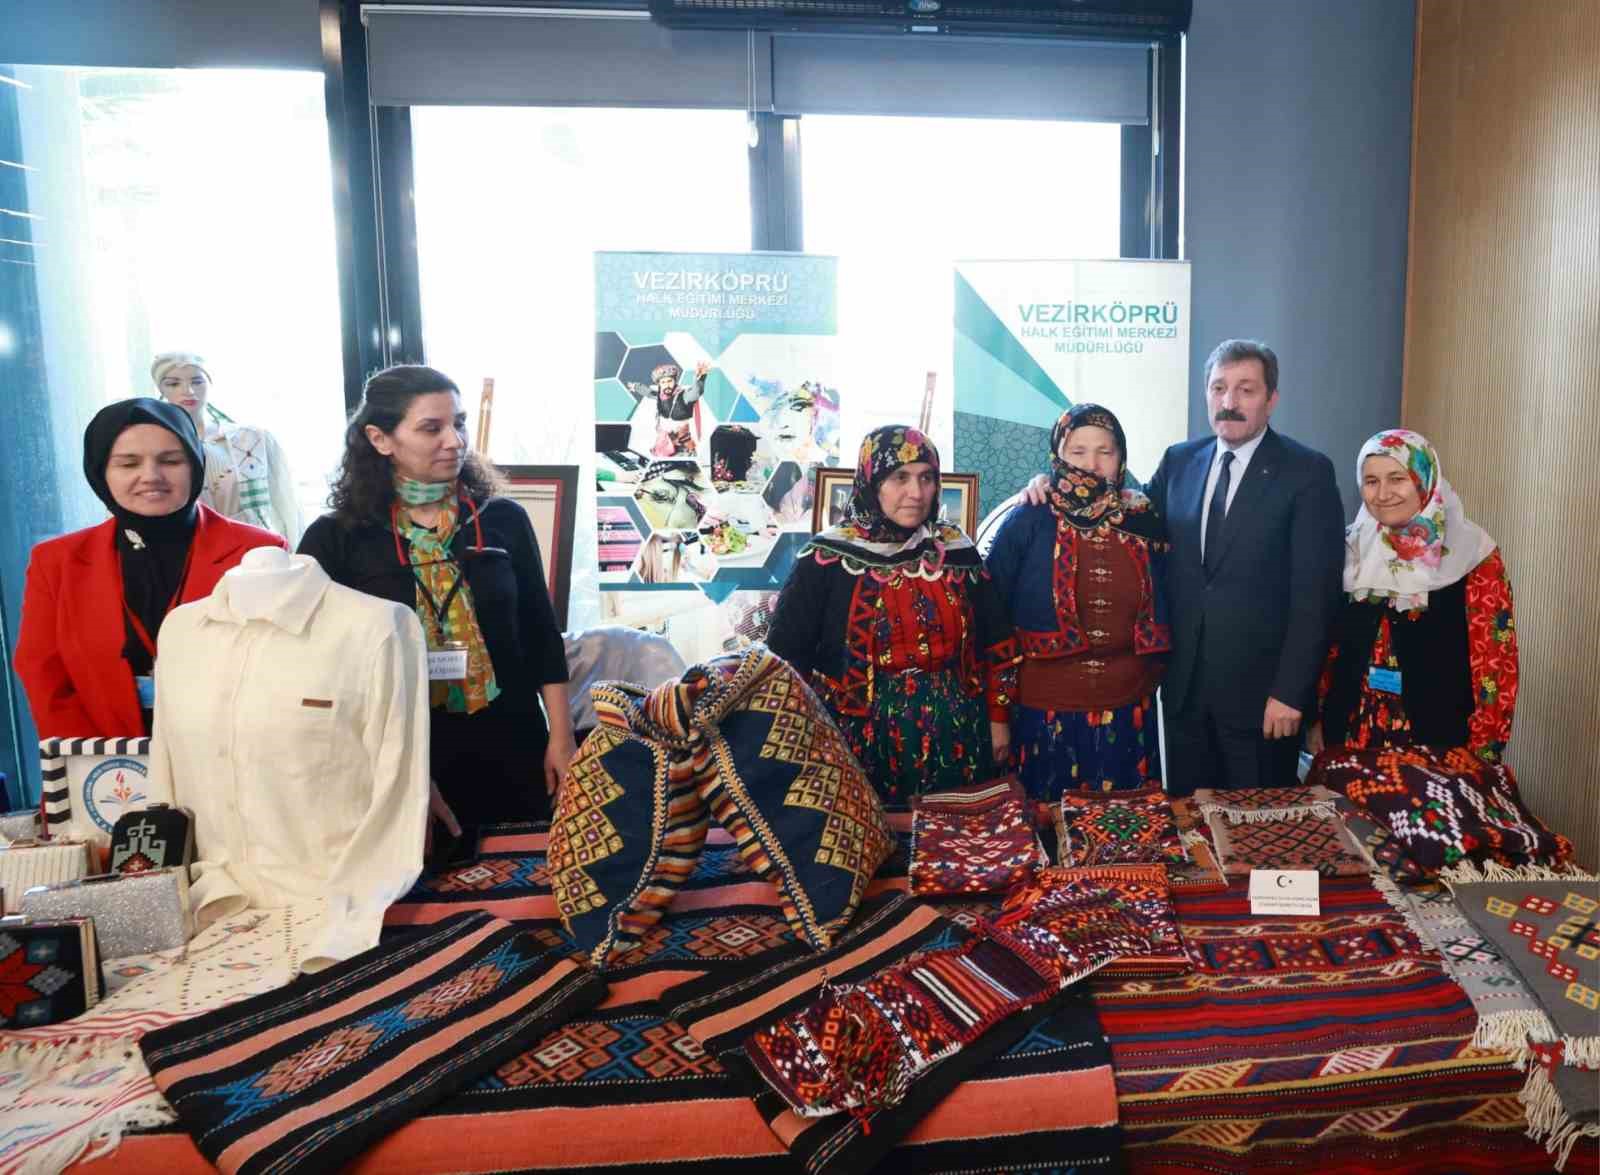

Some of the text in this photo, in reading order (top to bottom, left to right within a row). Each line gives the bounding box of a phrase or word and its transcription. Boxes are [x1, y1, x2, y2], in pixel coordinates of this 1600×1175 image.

[634, 270, 788, 292] VEZİRKÖPRÜ
[1018, 300, 1178, 324] VEZİRKÖPRÜ
[1020, 326, 1058, 338] HALK
[1117, 326, 1177, 339] MERKEZİ
